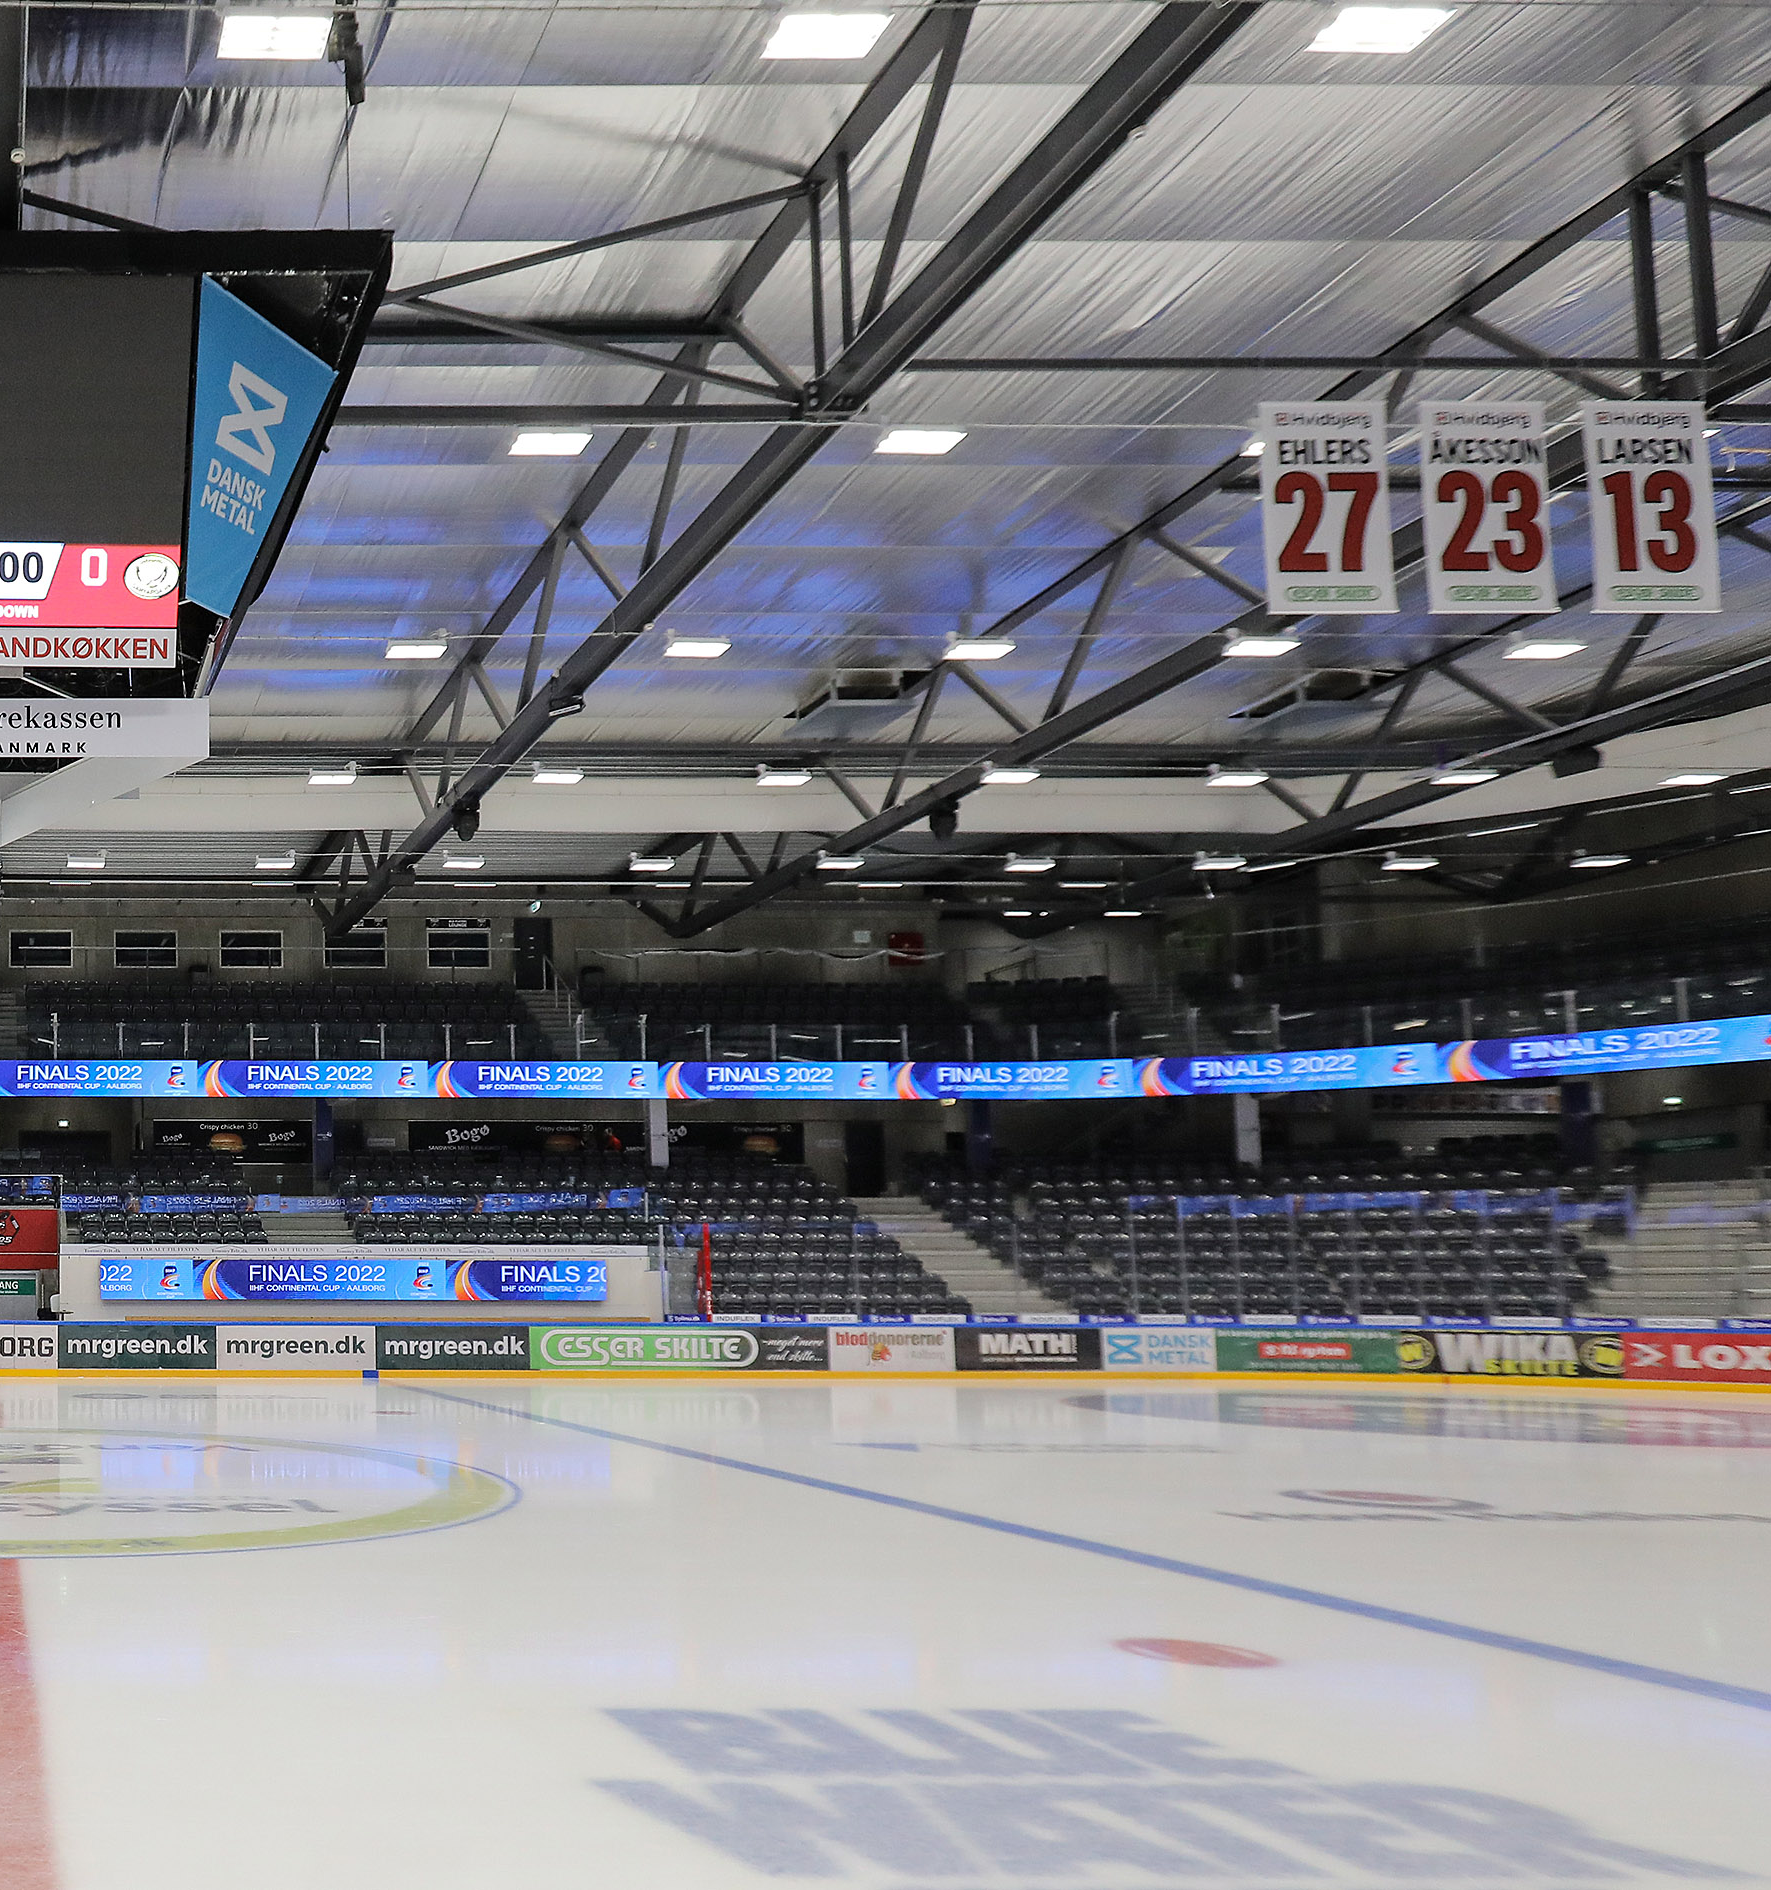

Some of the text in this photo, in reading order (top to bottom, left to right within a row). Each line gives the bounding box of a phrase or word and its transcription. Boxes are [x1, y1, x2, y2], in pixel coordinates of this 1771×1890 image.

[1278, 439, 1372, 465] EHLERS
[1430, 431, 1543, 464] ÅKESSON
[1596, 438, 1694, 464] LARSEN
[206, 457, 267, 512] DANSK
[199, 485, 257, 538] METAL
[1274, 470, 1380, 572] 27
[1437, 470, 1544, 573] 23
[1602, 470, 1698, 573] 13
[80, 547, 107, 588] 0
[1510, 1027, 1721, 1061] FINALS 2022
[17, 1065, 142, 1080] FINALS 2022
[248, 1066, 373, 1081] FINALS 2022
[478, 1066, 603, 1081] FINALS 2022
[707, 1067, 833, 1083] FINALS 2022
[937, 1067, 1070, 1083] FINALS 2022
[1191, 1054, 1357, 1080] FINALS 2022
[249, 1265, 386, 1282] FINALS 2022
[501, 1266, 580, 1282] FINALS
[67, 1335, 209, 1358] mrgreen.dk
[227, 1336, 366, 1358] mrgreen.dk
[385, 1336, 525, 1358] mrgreen.dk
[557, 1337, 742, 1360] ESSER SKILTE
[979, 1333, 1072, 1354] MATH
[1148, 1335, 1212, 1348] DANSK
[1434, 1333, 1578, 1373] WIKA
[1148, 1352, 1210, 1365] METAL
[597, 1707, 1318, 1779] BLUE
[584, 1778, 1768, 1879] WATER
